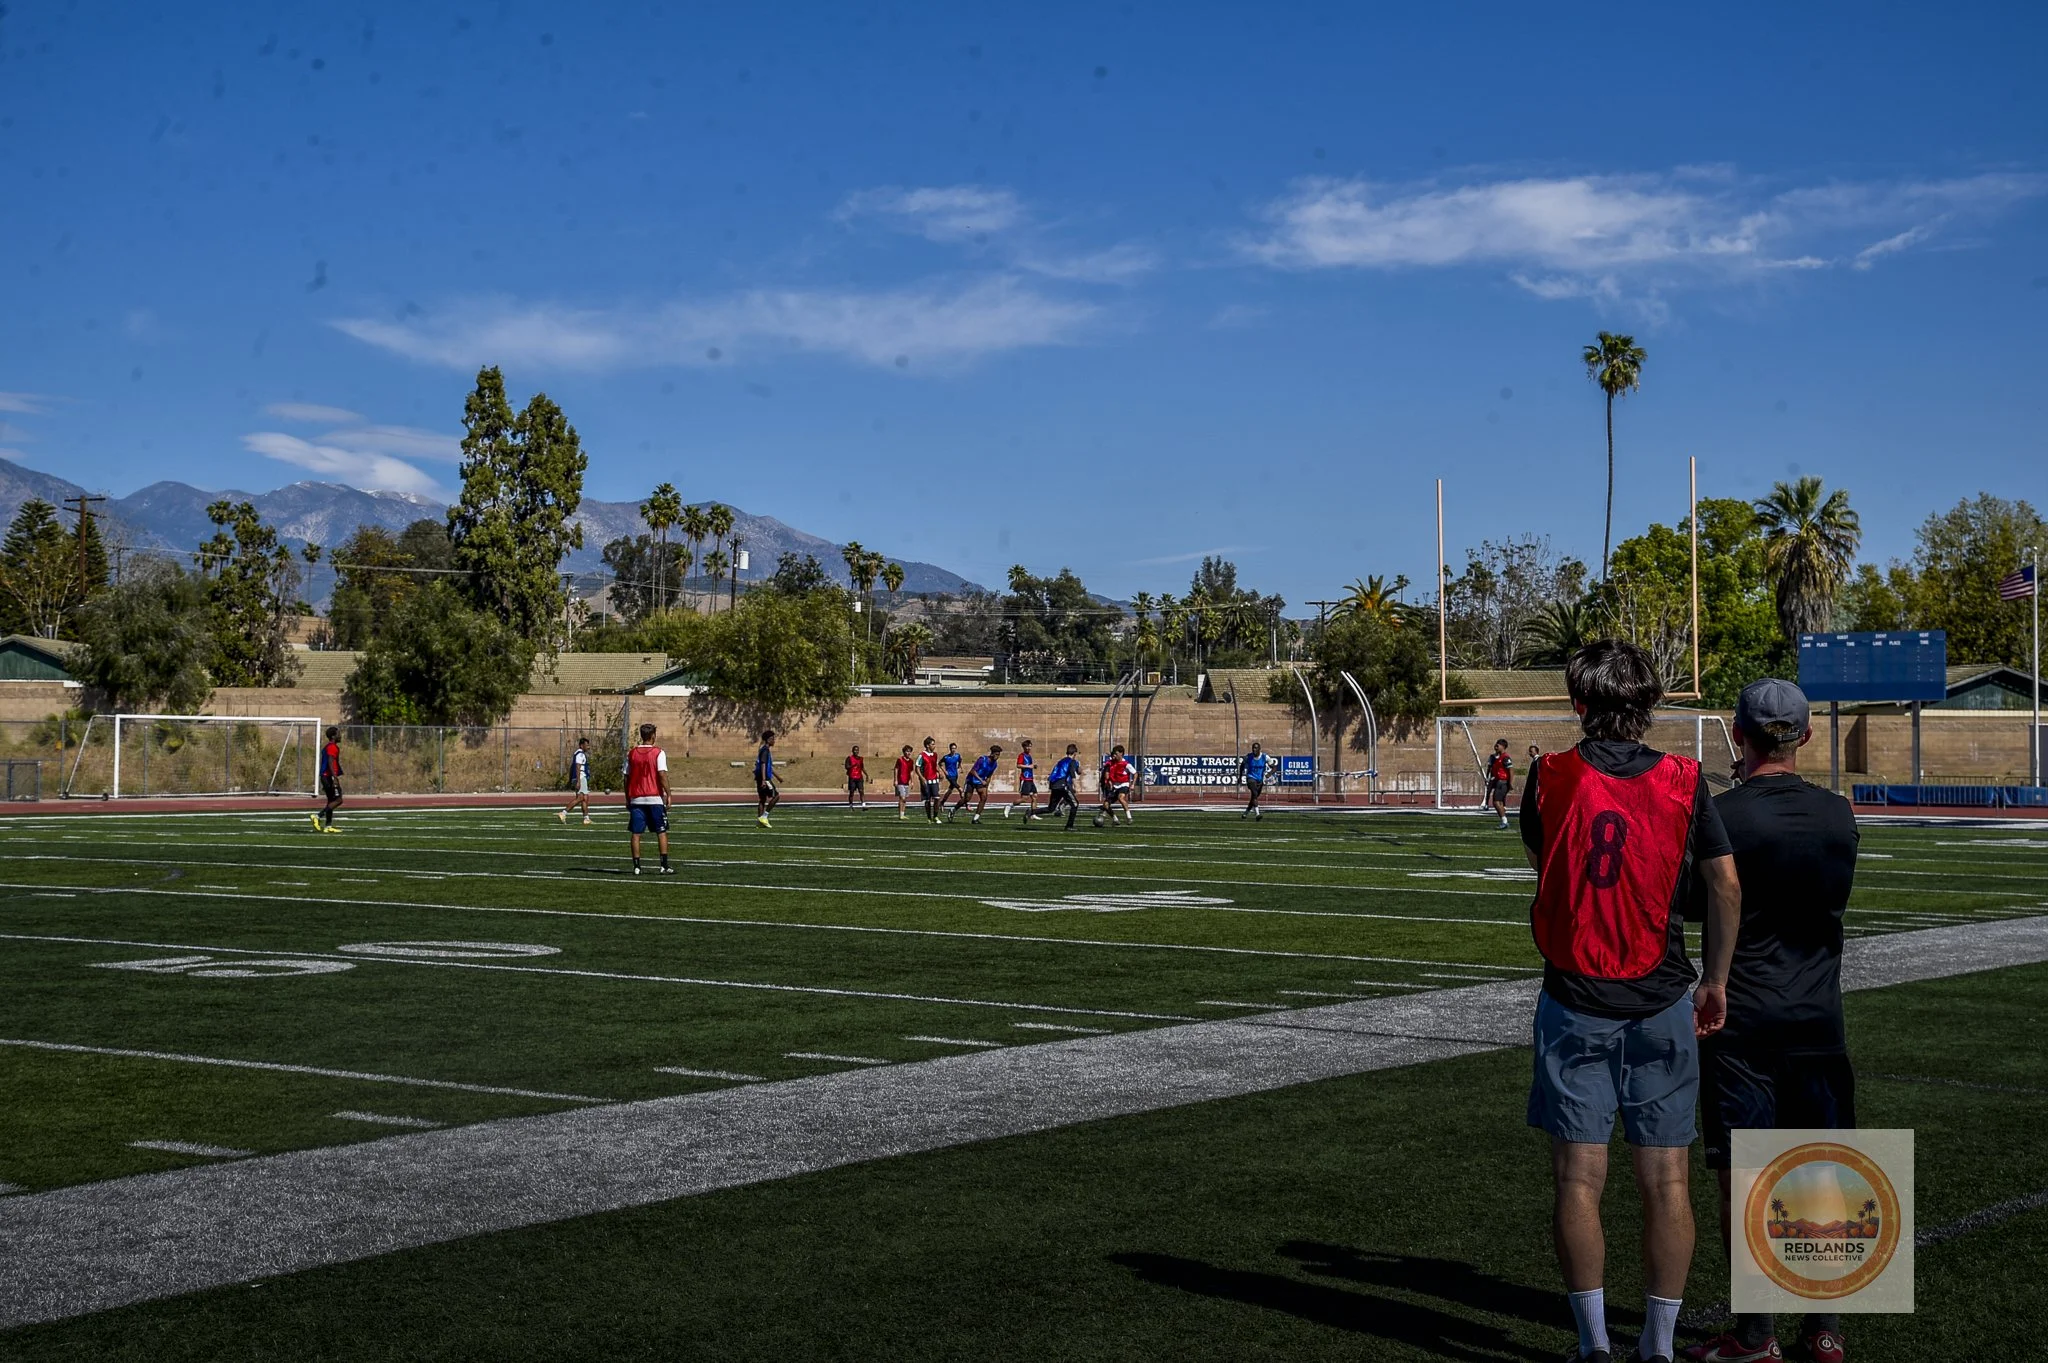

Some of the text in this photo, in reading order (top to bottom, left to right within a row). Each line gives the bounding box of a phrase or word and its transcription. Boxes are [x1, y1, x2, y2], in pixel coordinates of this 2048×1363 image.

[1144, 757, 1198, 766] REDLANDS
[1202, 757, 1237, 766] TRACK
[1288, 761, 1310, 769] GIRLS
[1160, 767, 1180, 775] CIF
[1587, 809, 1628, 889] 8
